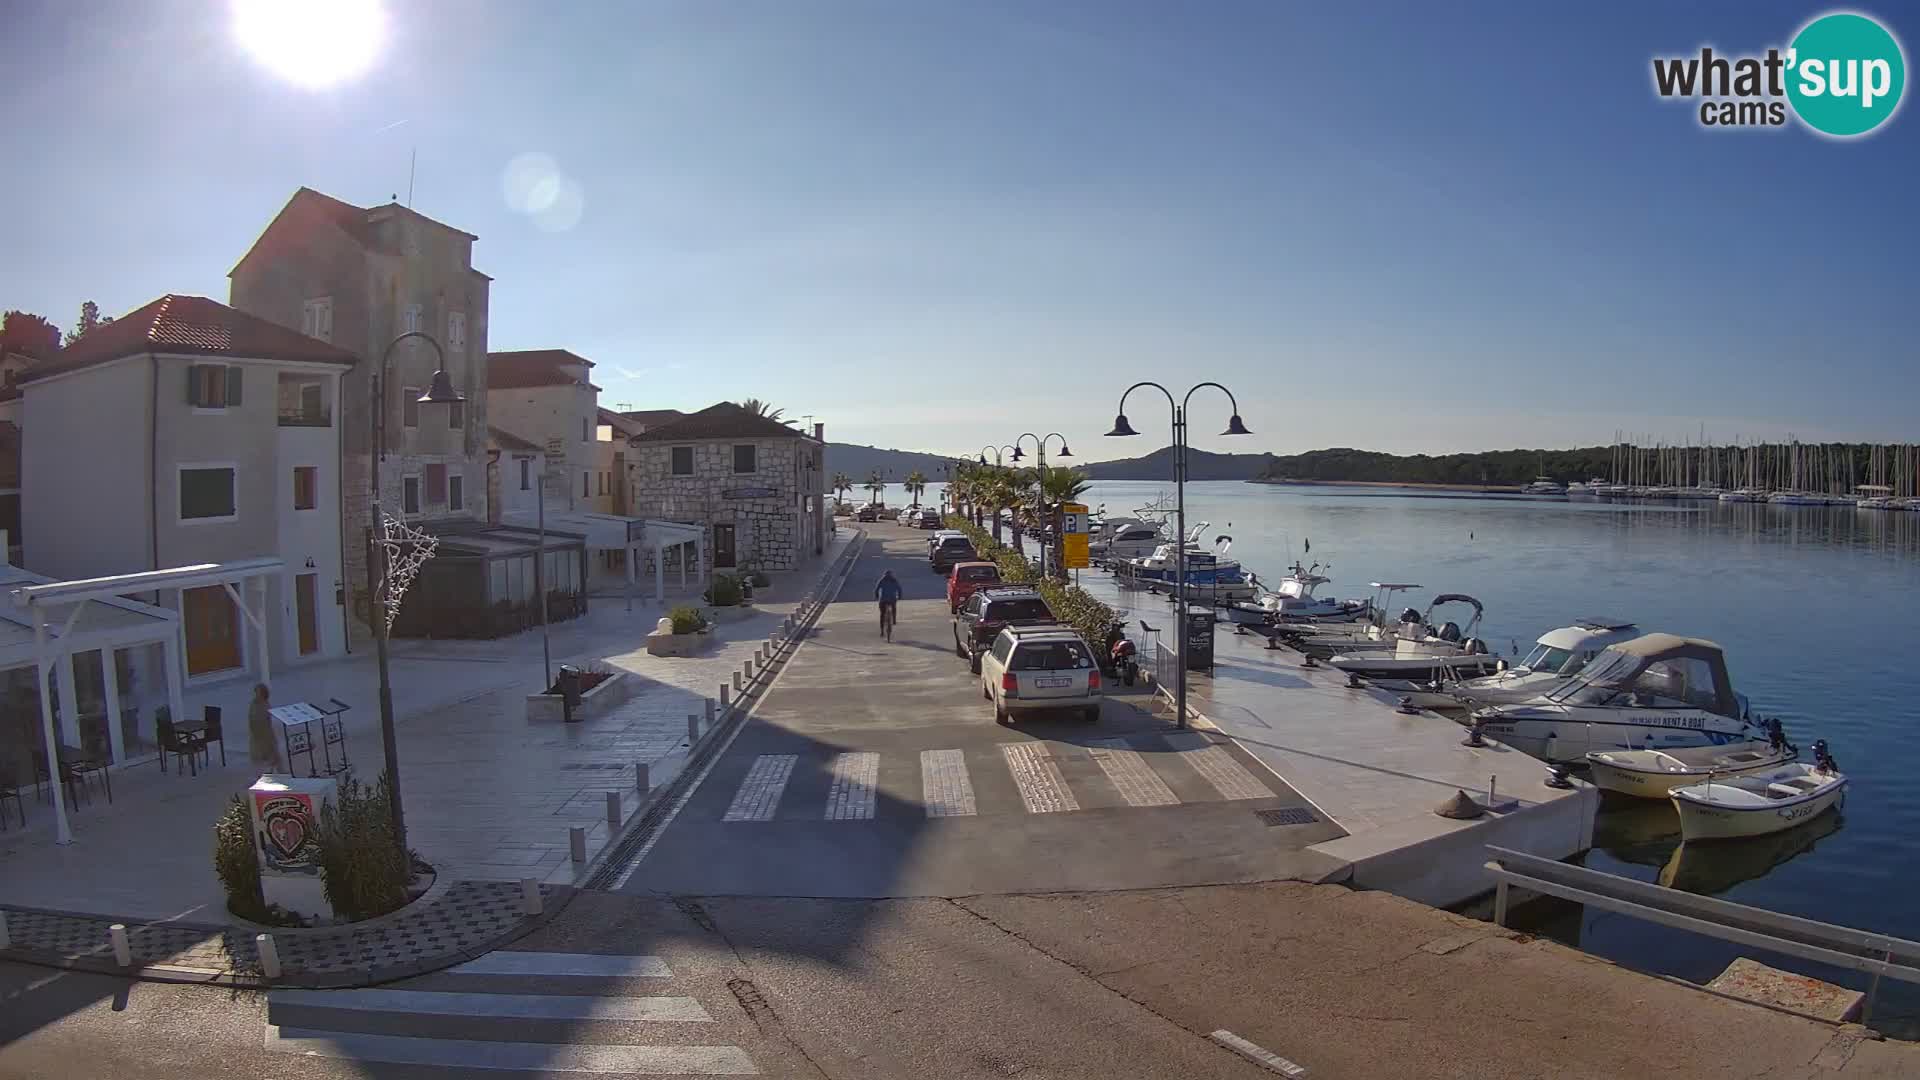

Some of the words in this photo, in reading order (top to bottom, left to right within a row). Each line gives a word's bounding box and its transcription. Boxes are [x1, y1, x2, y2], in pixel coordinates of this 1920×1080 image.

[1065, 515, 1076, 530] P
[1662, 717, 1681, 727] RENT
[1682, 717, 1687, 727] A
[1688, 717, 1706, 729] BOAT
